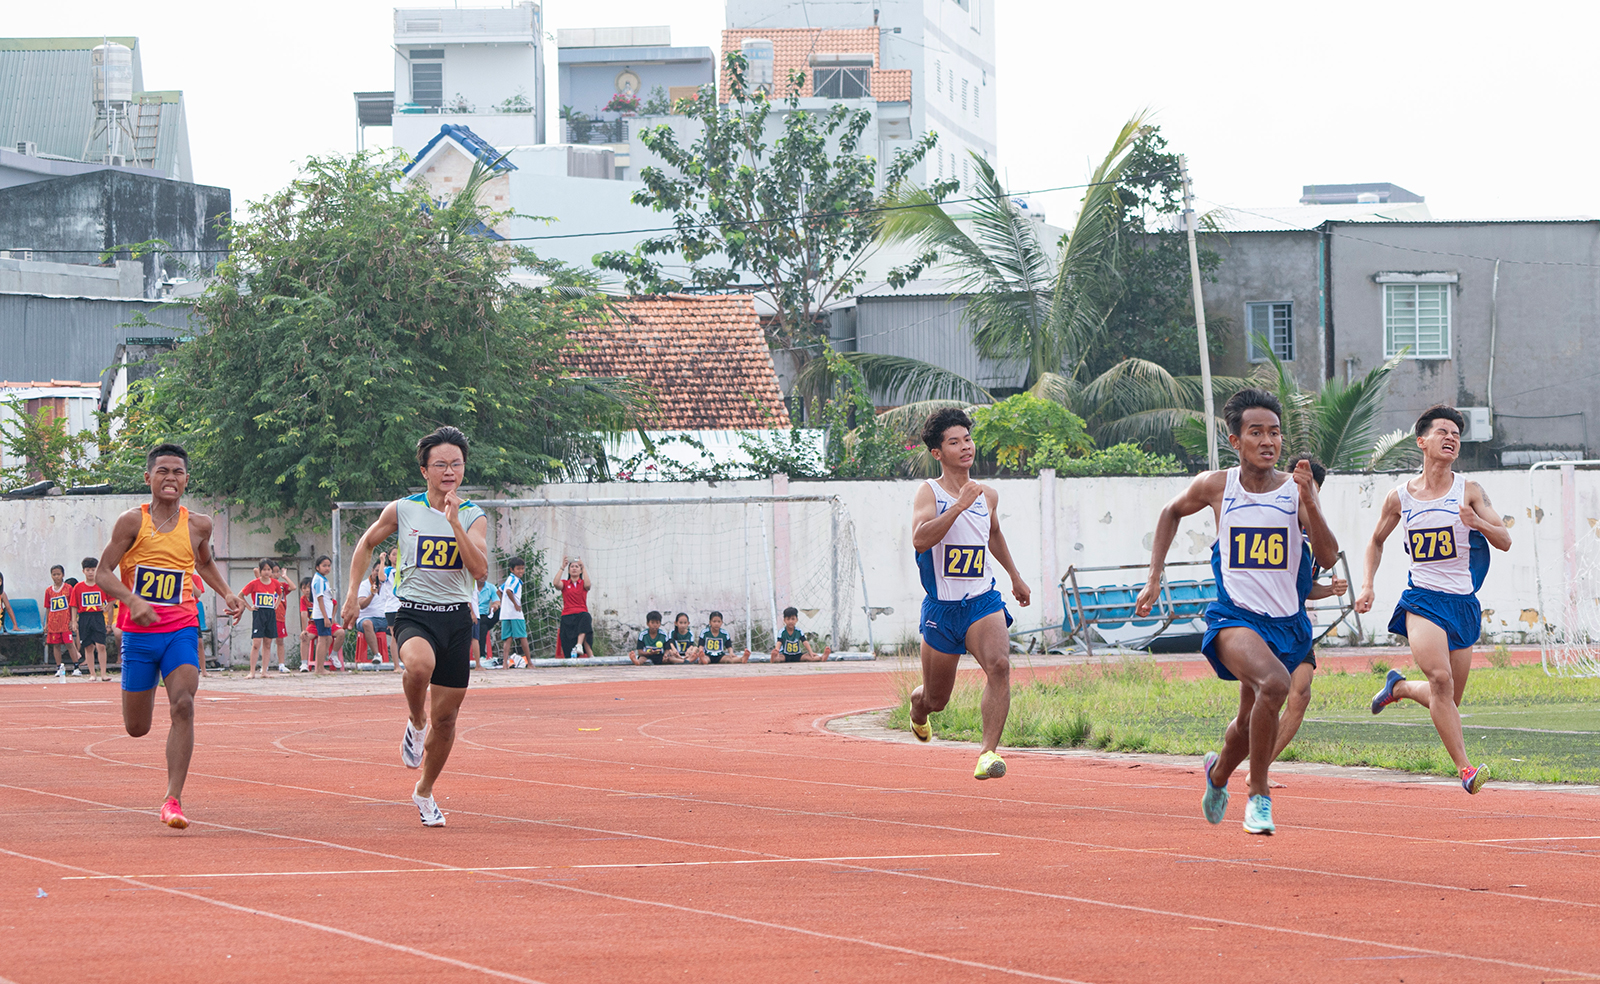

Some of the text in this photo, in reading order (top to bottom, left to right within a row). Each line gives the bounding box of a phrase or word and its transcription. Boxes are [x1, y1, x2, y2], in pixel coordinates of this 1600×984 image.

[1234, 533, 1284, 565] 146
[1412, 530, 1453, 558] 273
[421, 539, 459, 566] 237
[948, 548, 984, 574] 274
[140, 571, 176, 600] 210
[52, 598, 65, 610] 76
[84, 594, 100, 605] 107
[258, 595, 273, 606] 102
[414, 603, 460, 612] COMBAT
[707, 639, 720, 651] 66
[786, 642, 799, 653] 65
